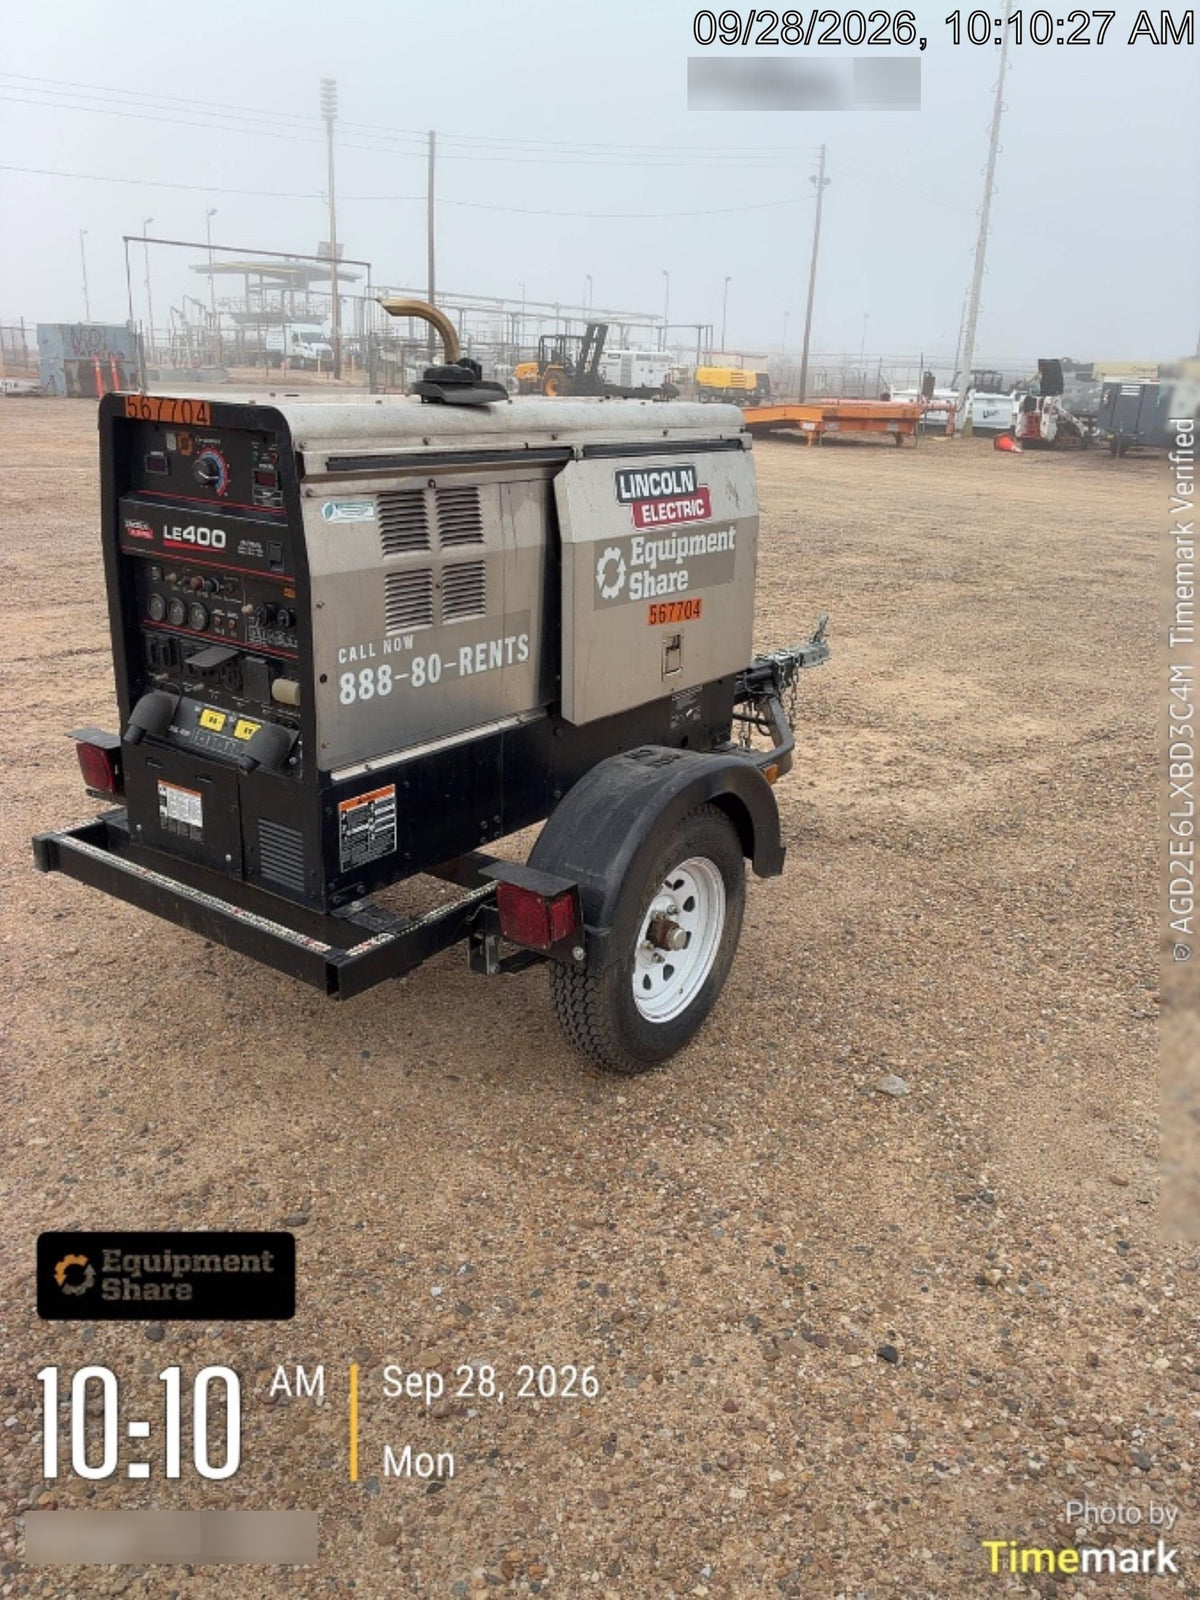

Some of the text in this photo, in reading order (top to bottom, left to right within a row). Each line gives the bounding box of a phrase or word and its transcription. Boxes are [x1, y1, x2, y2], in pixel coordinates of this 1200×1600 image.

[127, 396, 208, 425] 567704
[619, 470, 694, 499] LINCOLN
[641, 499, 705, 523] ELECTRIC
[163, 525, 226, 548] LE400
[630, 526, 736, 569] Equipment
[629, 569, 689, 600] Share
[649, 601, 701, 625] 567704
[338, 634, 415, 663] CALL NOW
[339, 633, 529, 705] 888-80-RENTS
